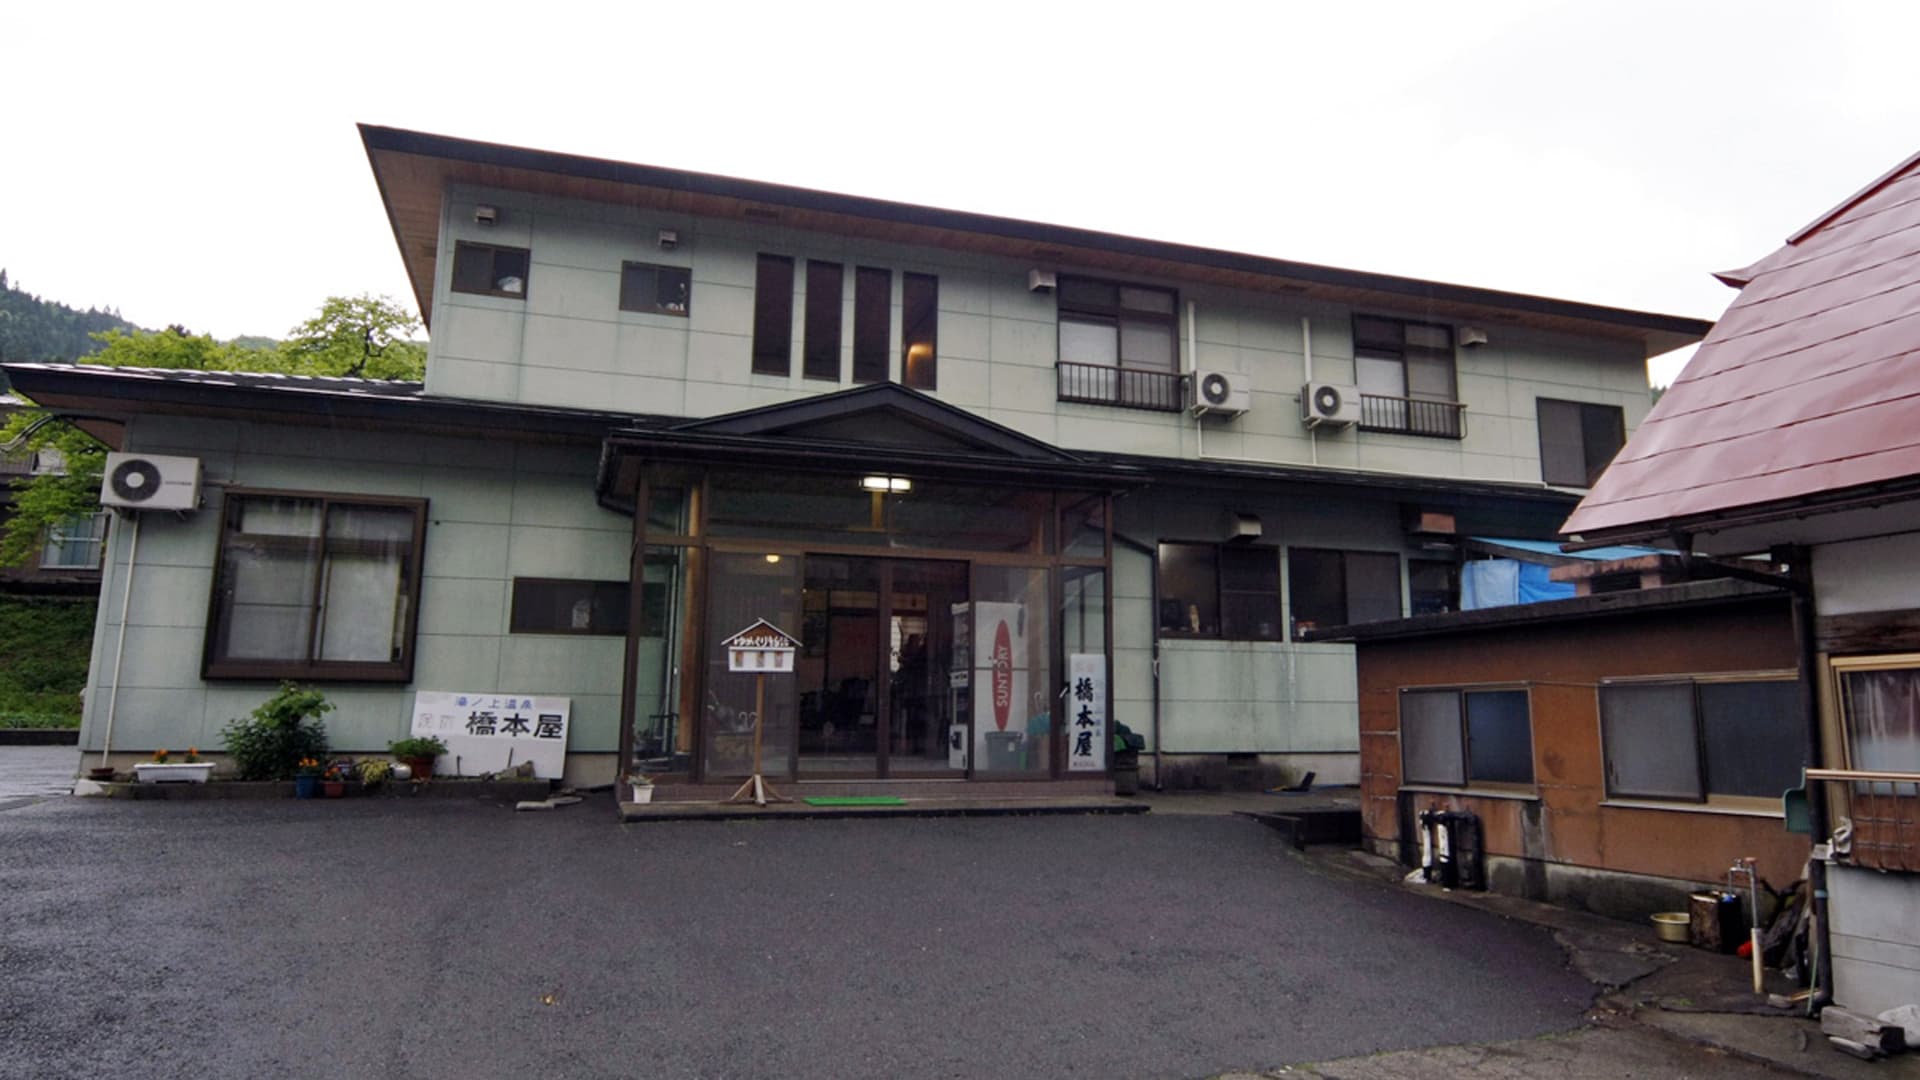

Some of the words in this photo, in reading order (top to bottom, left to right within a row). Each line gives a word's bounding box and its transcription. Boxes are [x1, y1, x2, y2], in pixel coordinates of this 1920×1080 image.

[464, 711, 563, 739] 橋本屋
[1073, 677, 1095, 757] 橋本屋
